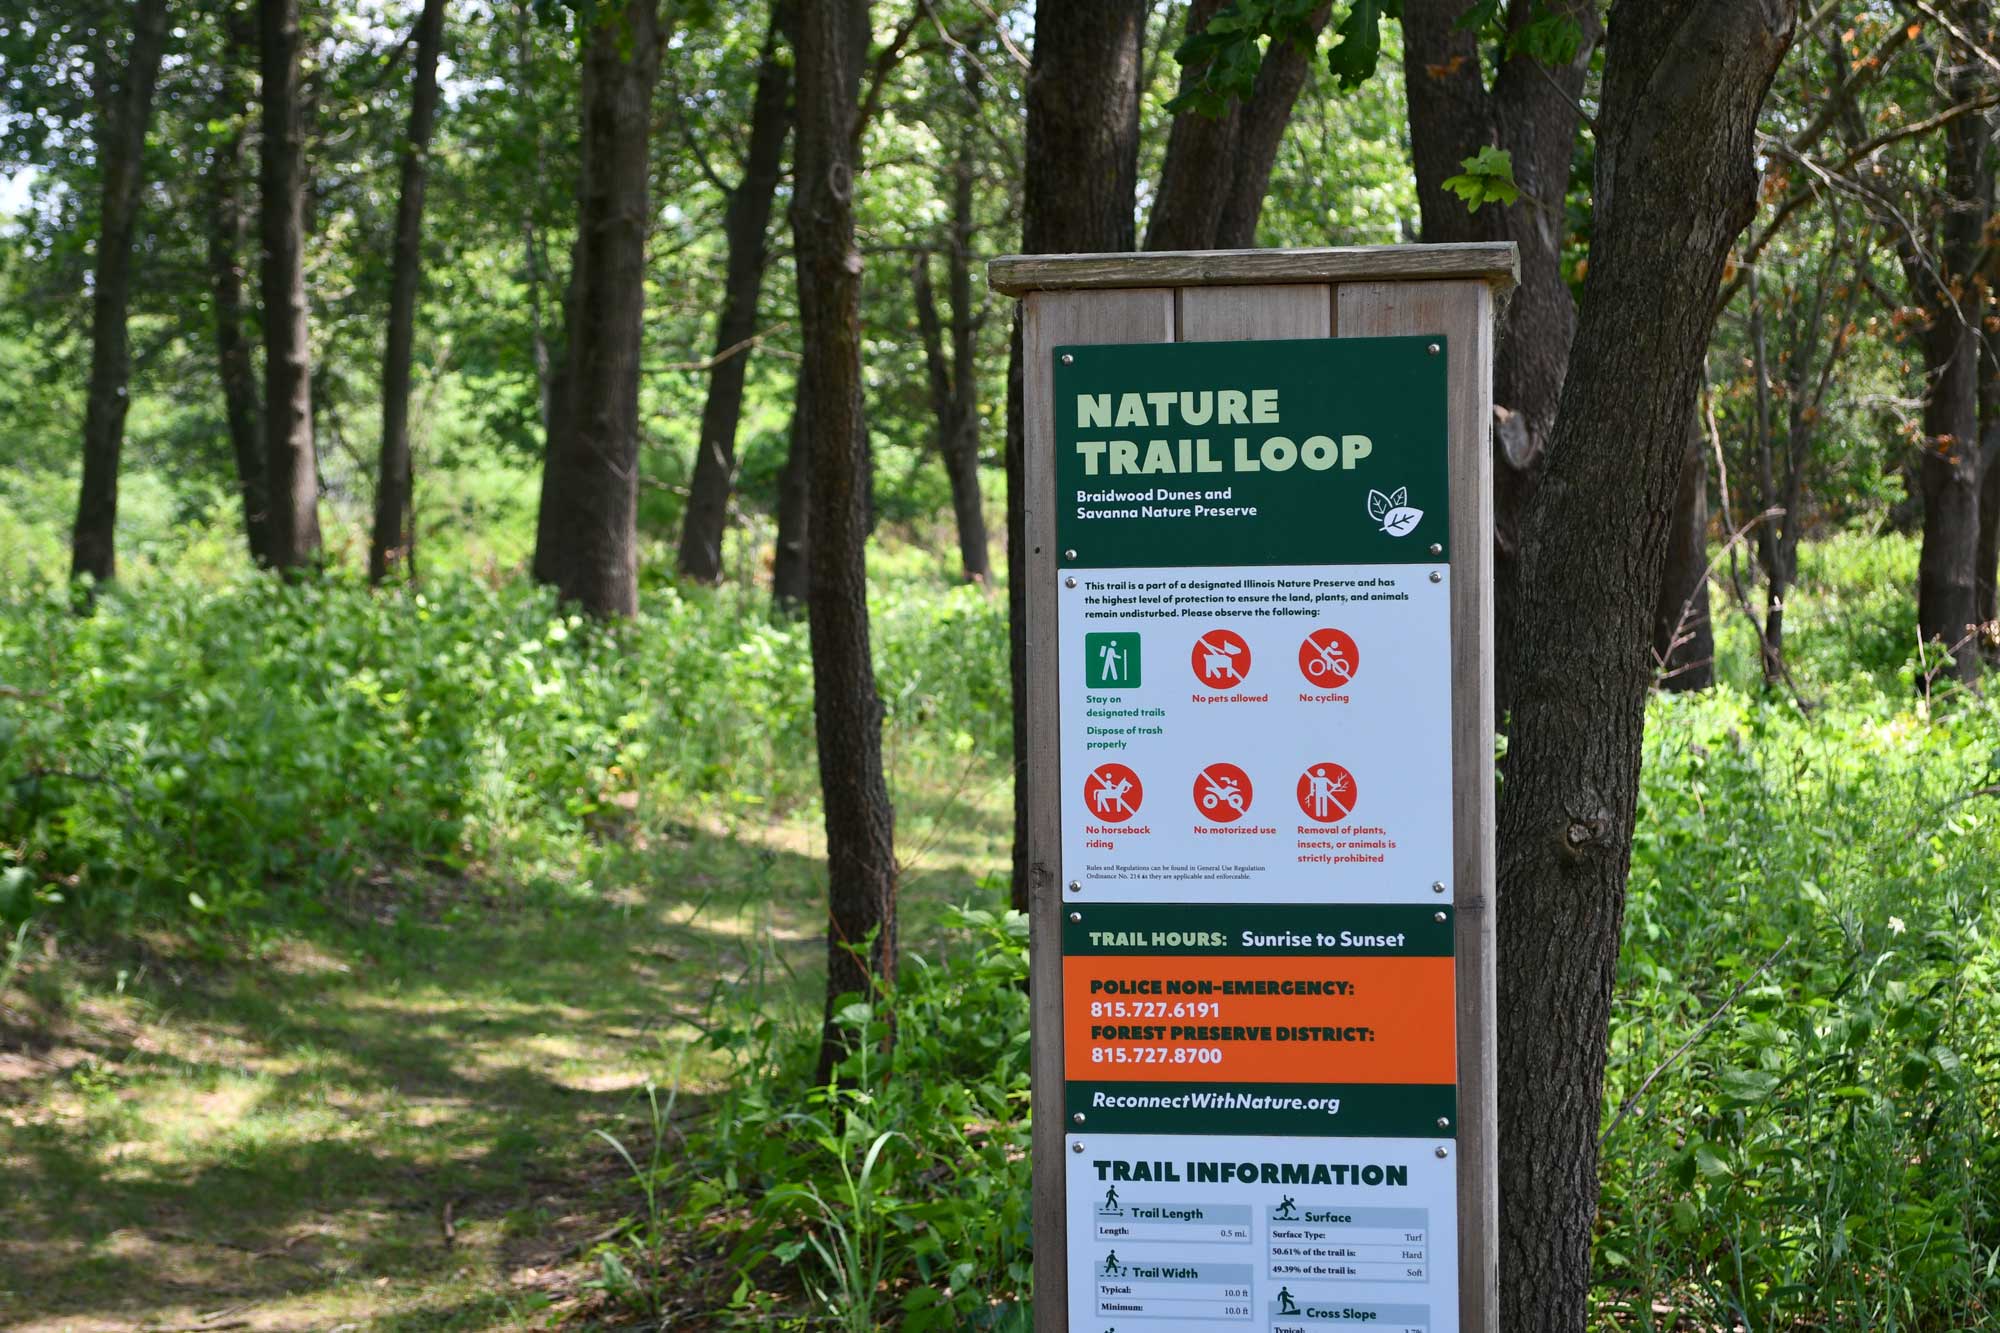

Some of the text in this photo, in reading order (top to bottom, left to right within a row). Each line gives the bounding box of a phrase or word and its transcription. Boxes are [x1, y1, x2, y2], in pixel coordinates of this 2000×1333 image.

[1077, 389, 1280, 428] NATURE
[1076, 435, 1372, 475] TRAIL LOOP
[1077, 487, 1231, 502] Braidwood Dunes and
[1077, 505, 1257, 519] Savanna Nature Preserve
[1084, 582, 1105, 590] This
[1106, 581, 1126, 590] trail
[1128, 581, 1136, 590] is
[1146, 582, 1166, 592] part
[1168, 580, 1179, 589] of
[1188, 580, 1242, 591] designated
[1244, 579, 1275, 588] Illinois
[1277, 579, 1311, 588] Nature
[1313, 579, 1356, 587] Preserve
[1357, 578, 1376, 587] and
[1378, 578, 1395, 586] has
[1084, 595, 1100, 604] the
[1102, 595, 1137, 606] highest
[1139, 595, 1161, 604] level
[1162, 594, 1173, 603] of
[1174, 594, 1224, 605] protection
[1226, 595, 1236, 603] to
[1271, 593, 1287, 602] the
[1289, 593, 1313, 603] land,
[1315, 593, 1348, 604] plants,
[1350, 592, 1369, 601] and
[1370, 592, 1409, 601] animals
[1085, 607, 1320, 618] remain undisturbed. Please observe the following:
[1086, 695, 1108, 705] Stay
[1192, 694, 1268, 705] No pets allowed
[1299, 693, 1349, 704] No cycling
[1086, 708, 1165, 719] designated trails
[1087, 726, 1163, 737] Dispose of trash
[1087, 739, 1127, 750] properly
[1086, 825, 1150, 834] No horseback
[1194, 826, 1208, 834] No
[1209, 825, 1258, 834] motorized
[1297, 825, 1386, 836] Removal of plants,
[1086, 839, 1114, 850] riding
[1297, 840, 1334, 850] insects,
[1348, 840, 1386, 848] animals
[1388, 840, 1396, 848] is
[1298, 854, 1384, 864] strictly prohibited
[1089, 931, 1405, 947] TRAIL HOURS: Sunrise to Sunset
[1090, 980, 1354, 996] POLICE NON-EMERGENCY:
[1091, 1002, 1219, 1018] 815.727.6191
[1091, 1025, 1374, 1042] FOREST PRESERVE DISTRICT:
[1092, 1047, 1222, 1064] 815.727.8700
[1092, 1092, 1340, 1114] ReconnectWithNature.org
[1093, 1160, 1408, 1186] TRAIL INFORMATION
[1131, 1207, 1203, 1222] Trail Length
[1305, 1211, 1351, 1223] Surface
[1100, 1227, 1129, 1236] Length:
[1234, 1230, 1247, 1238] mi.
[1272, 1230, 1326, 1241] Surface Type:
[1404, 1233, 1422, 1241] Turf
[1302, 1248, 1311, 1256] of
[1313, 1248, 1326, 1256] the
[1347, 1249, 1356, 1257] is:
[1402, 1251, 1422, 1259] Hard
[1132, 1267, 1198, 1279] Trail Width
[1272, 1265, 1302, 1273] 49.39%
[1313, 1266, 1326, 1274] the
[1328, 1266, 1345, 1274] trail
[1407, 1269, 1422, 1277] Soft
[1101, 1285, 1131, 1295] Typical:
[1225, 1289, 1241, 1297] 10.0
[1101, 1303, 1143, 1311] Minimum:
[1225, 1307, 1248, 1315] 10.0 ft
[1306, 1307, 1376, 1322] Cross Slope
